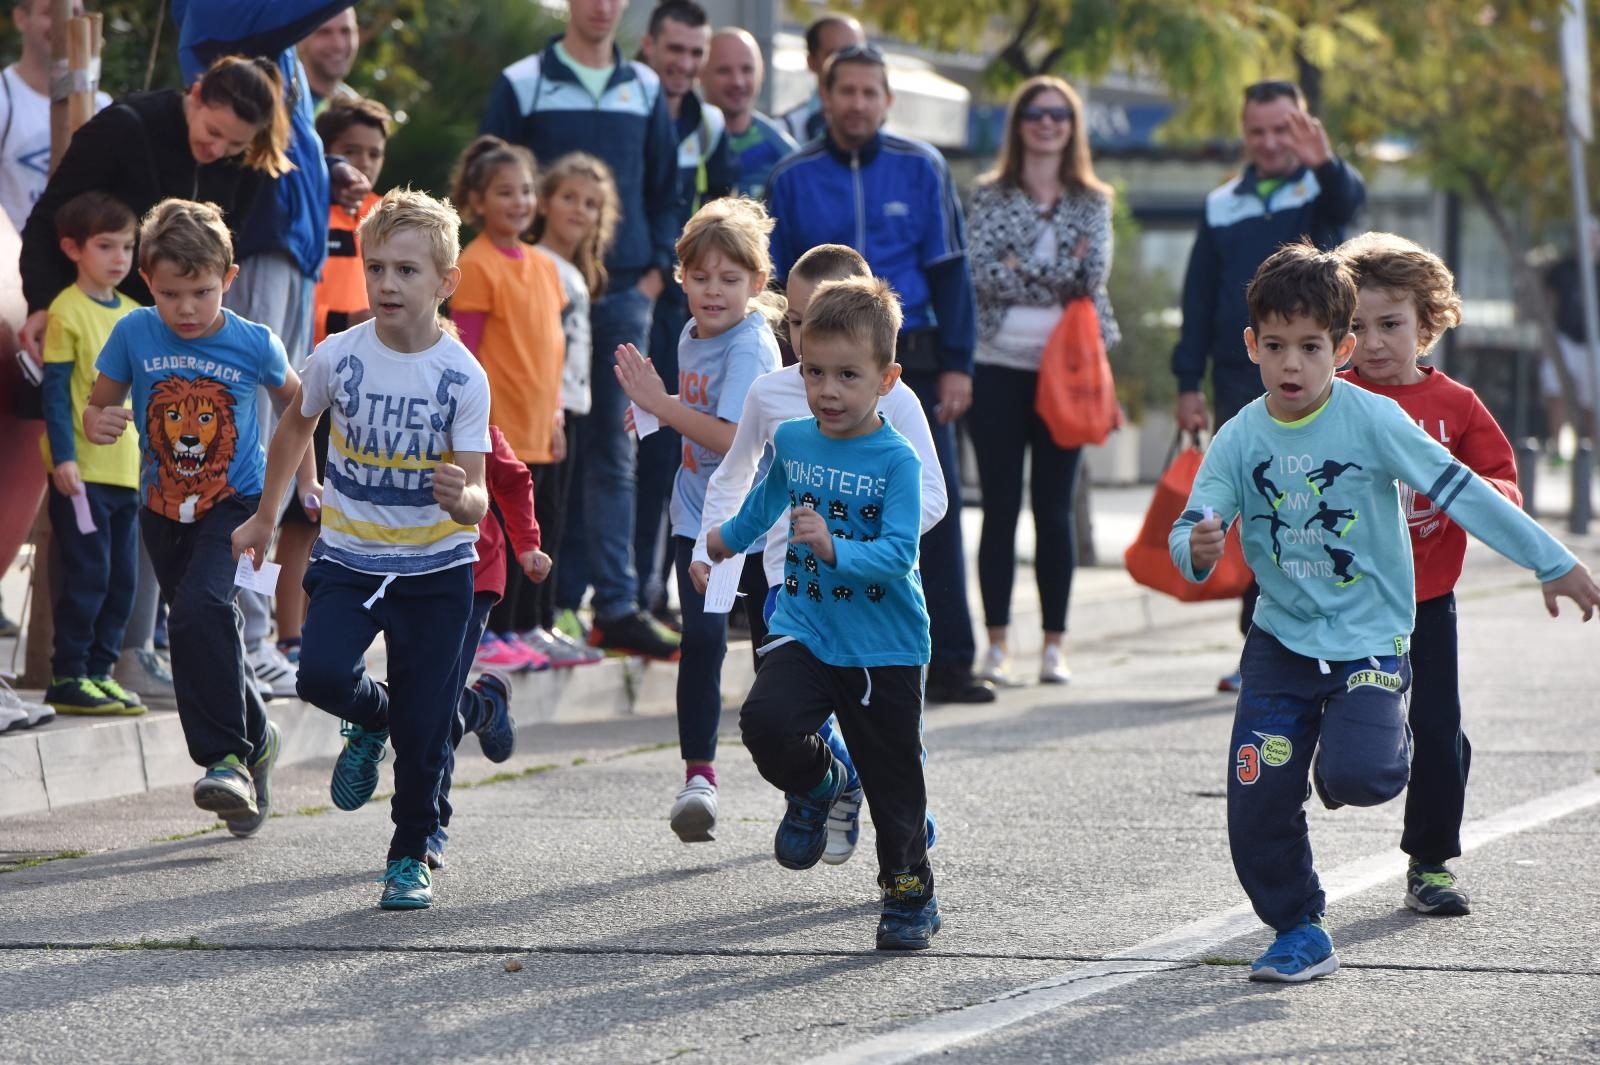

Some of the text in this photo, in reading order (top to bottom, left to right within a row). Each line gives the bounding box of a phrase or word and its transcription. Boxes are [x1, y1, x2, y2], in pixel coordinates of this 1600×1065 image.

[143, 356, 196, 373] LEADER
[204, 360, 242, 382] PACK
[334, 354, 364, 418] 3
[366, 393, 428, 430] THE
[345, 423, 442, 461] NAVAL
[344, 458, 436, 489] STATE
[782, 458, 886, 498] MONSTERS
[1287, 454, 1313, 474] DO
[1286, 493, 1310, 511] MY
[1284, 528, 1324, 545] OWN
[1281, 560, 1333, 579] STUNTS
[1350, 671, 1400, 688] OFF ROAD
[1237, 743, 1260, 786] 3
